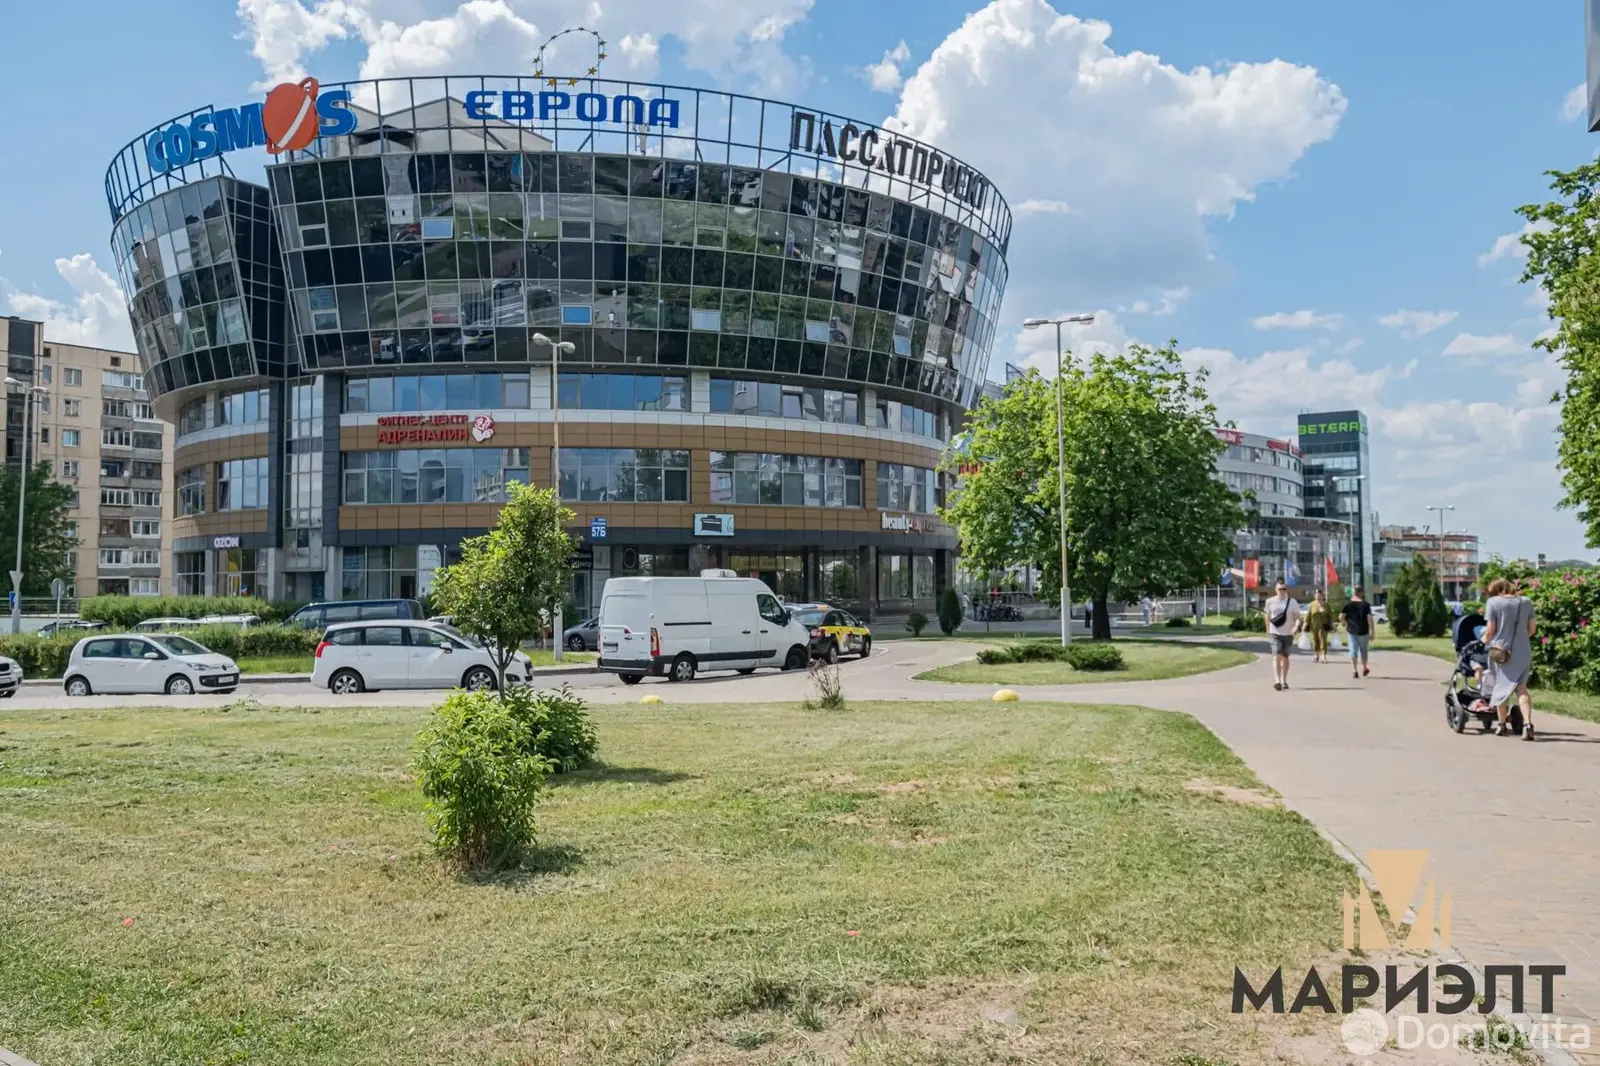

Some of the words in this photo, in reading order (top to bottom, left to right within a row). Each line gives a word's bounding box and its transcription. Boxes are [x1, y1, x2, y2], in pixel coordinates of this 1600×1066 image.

[792, 111, 989, 211] ПАССАТПРОЕКТ
[377, 414, 469, 427] ФИТНЕС-ЦЕНТР
[377, 428, 470, 444] АДРЕНАЛИН
[1297, 421, 1359, 436] BETERA
[881, 512, 912, 534] beauty
[213, 536, 240, 549] OZON
